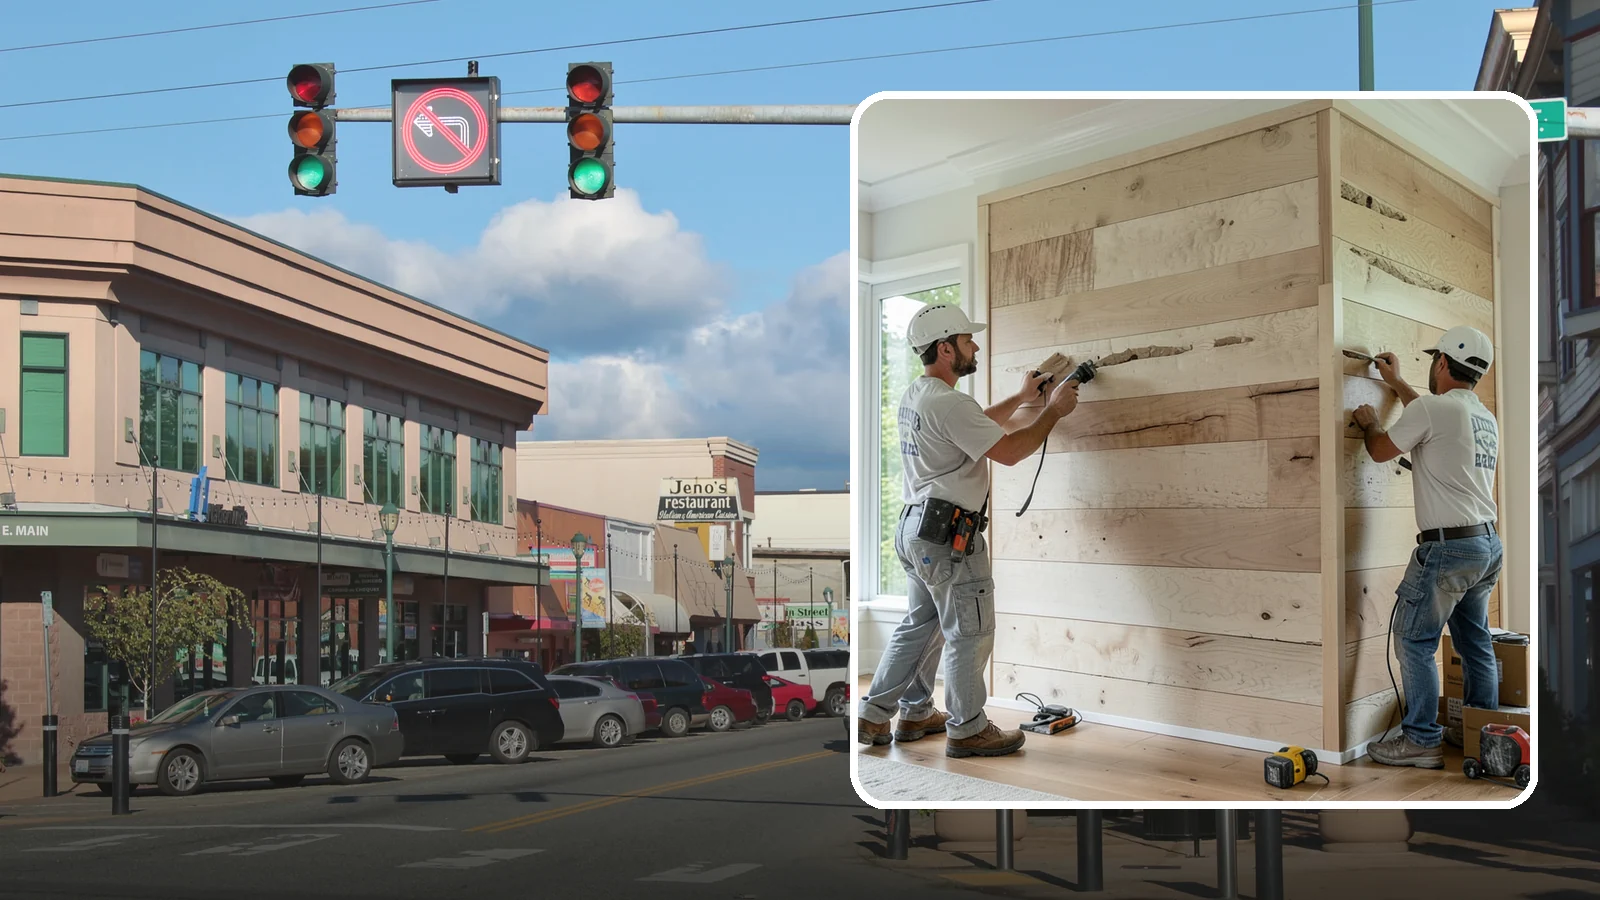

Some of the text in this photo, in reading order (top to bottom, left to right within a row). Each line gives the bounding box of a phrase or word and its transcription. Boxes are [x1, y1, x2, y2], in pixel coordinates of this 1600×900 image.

[670, 480, 727, 494] Jeno's
[665, 496, 731, 509] restaurant
[686, 509, 714, 519] American
[715, 510, 738, 519] Cuisine
[2, 525, 49, 536] E. MAIN
[797, 607, 828, 616] Street
